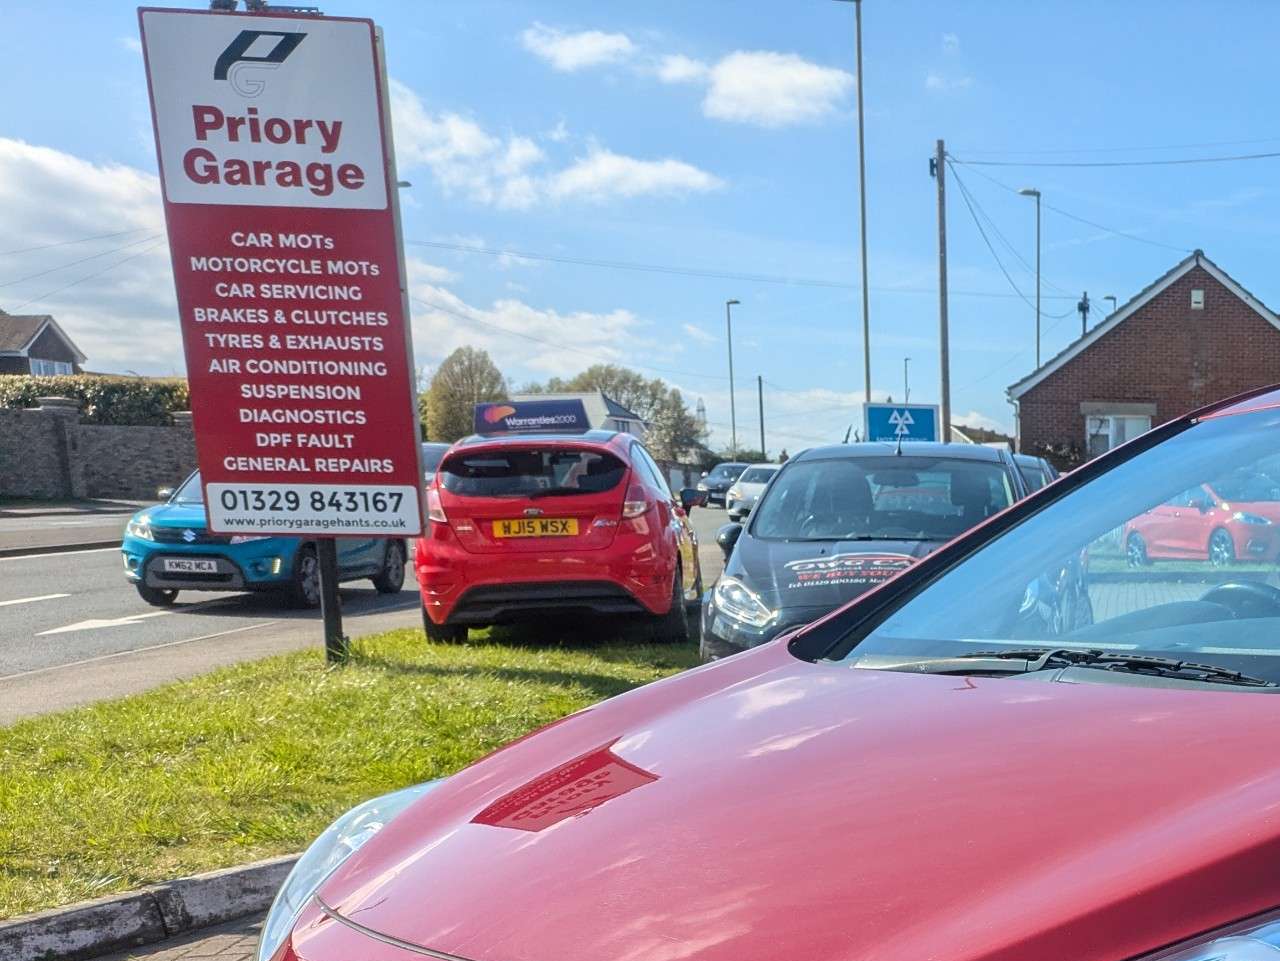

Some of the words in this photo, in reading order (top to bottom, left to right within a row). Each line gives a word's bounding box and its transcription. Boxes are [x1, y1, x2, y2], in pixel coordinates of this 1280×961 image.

[192, 104, 343, 153] Priory
[183, 147, 365, 197] Garage
[231, 232, 273, 248] CAR
[279, 234, 334, 250] MOTs
[190, 256, 322, 274] MOTORCYCLE
[327, 260, 380, 276] MOTs
[215, 283, 255, 298] CAR
[260, 284, 362, 300] SERVICING
[194, 308, 269, 324] BRAKES
[274, 309, 287, 324] &
[291, 310, 389, 326] CLUTCHES
[205, 333, 264, 349] TYRES
[269, 335, 281, 349] &
[286, 335, 384, 351] EXHAUSTS
[209, 358, 242, 373] AIR
[246, 359, 387, 377] CONDITIONING
[241, 384, 361, 400] SUSPENSION
[239, 409, 367, 425] DIAGNOSTICS
[256, 433, 292, 447] DPF
[297, 434, 355, 449] FAULT
[223, 456, 310, 472] GENERAL
[315, 457, 394, 473] REPAIRS
[221, 489, 300, 512] 01329
[310, 491, 404, 513] 843167
[224, 516, 406, 529] www.priorygaragehants.co.uk
[502, 521, 536, 535] WJ15
[540, 520, 570, 534] WSX
